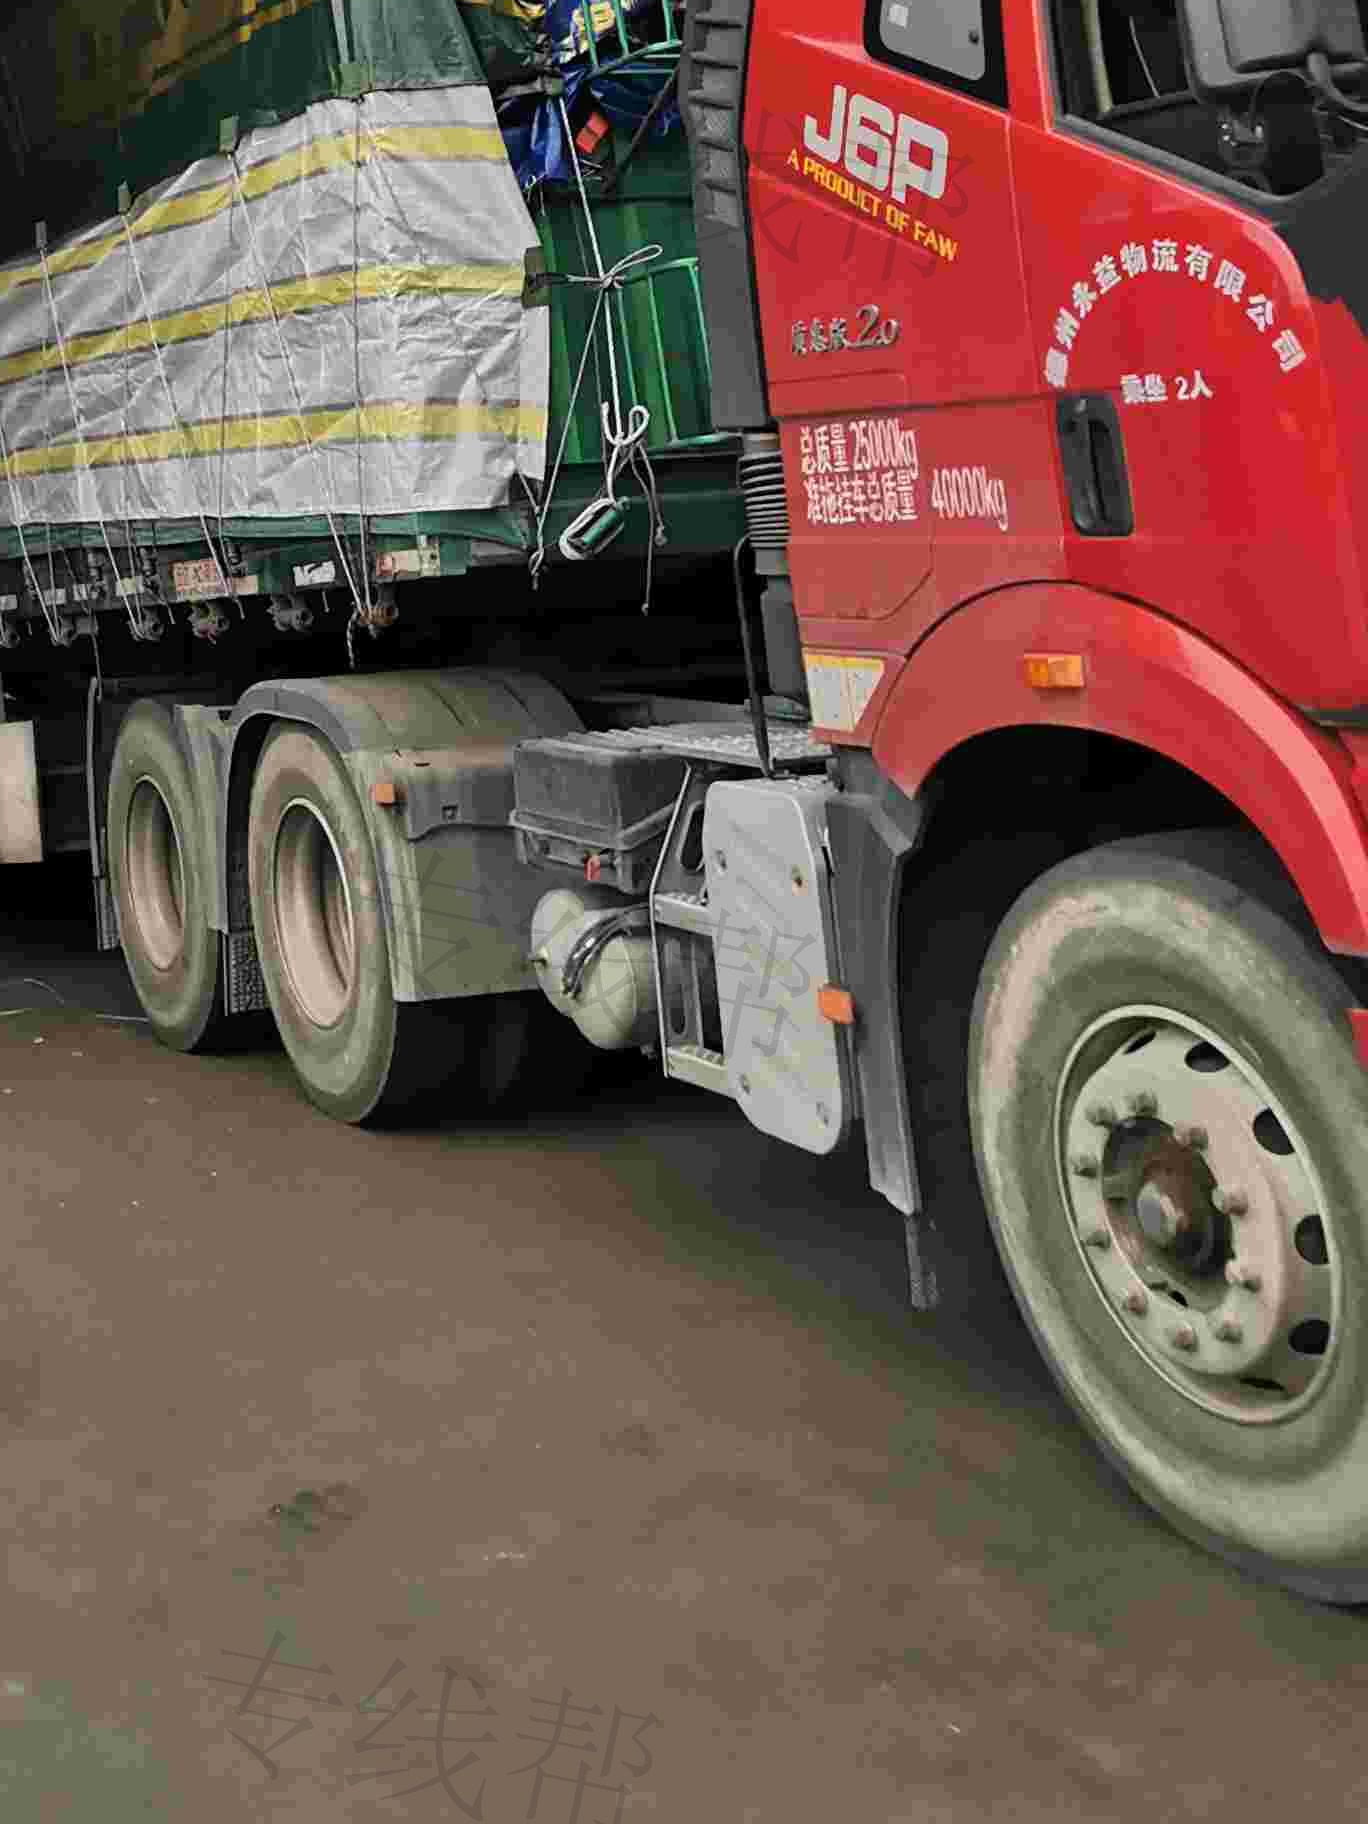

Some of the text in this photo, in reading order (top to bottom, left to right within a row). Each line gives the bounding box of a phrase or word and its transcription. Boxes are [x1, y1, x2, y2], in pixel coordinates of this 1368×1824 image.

[804, 84, 949, 204] J6P
[786, 147, 961, 263] A PRODUCT OF FAW
[800, 417, 920, 480] 总质量 25000kg
[931, 465, 1009, 532] 40000kg
